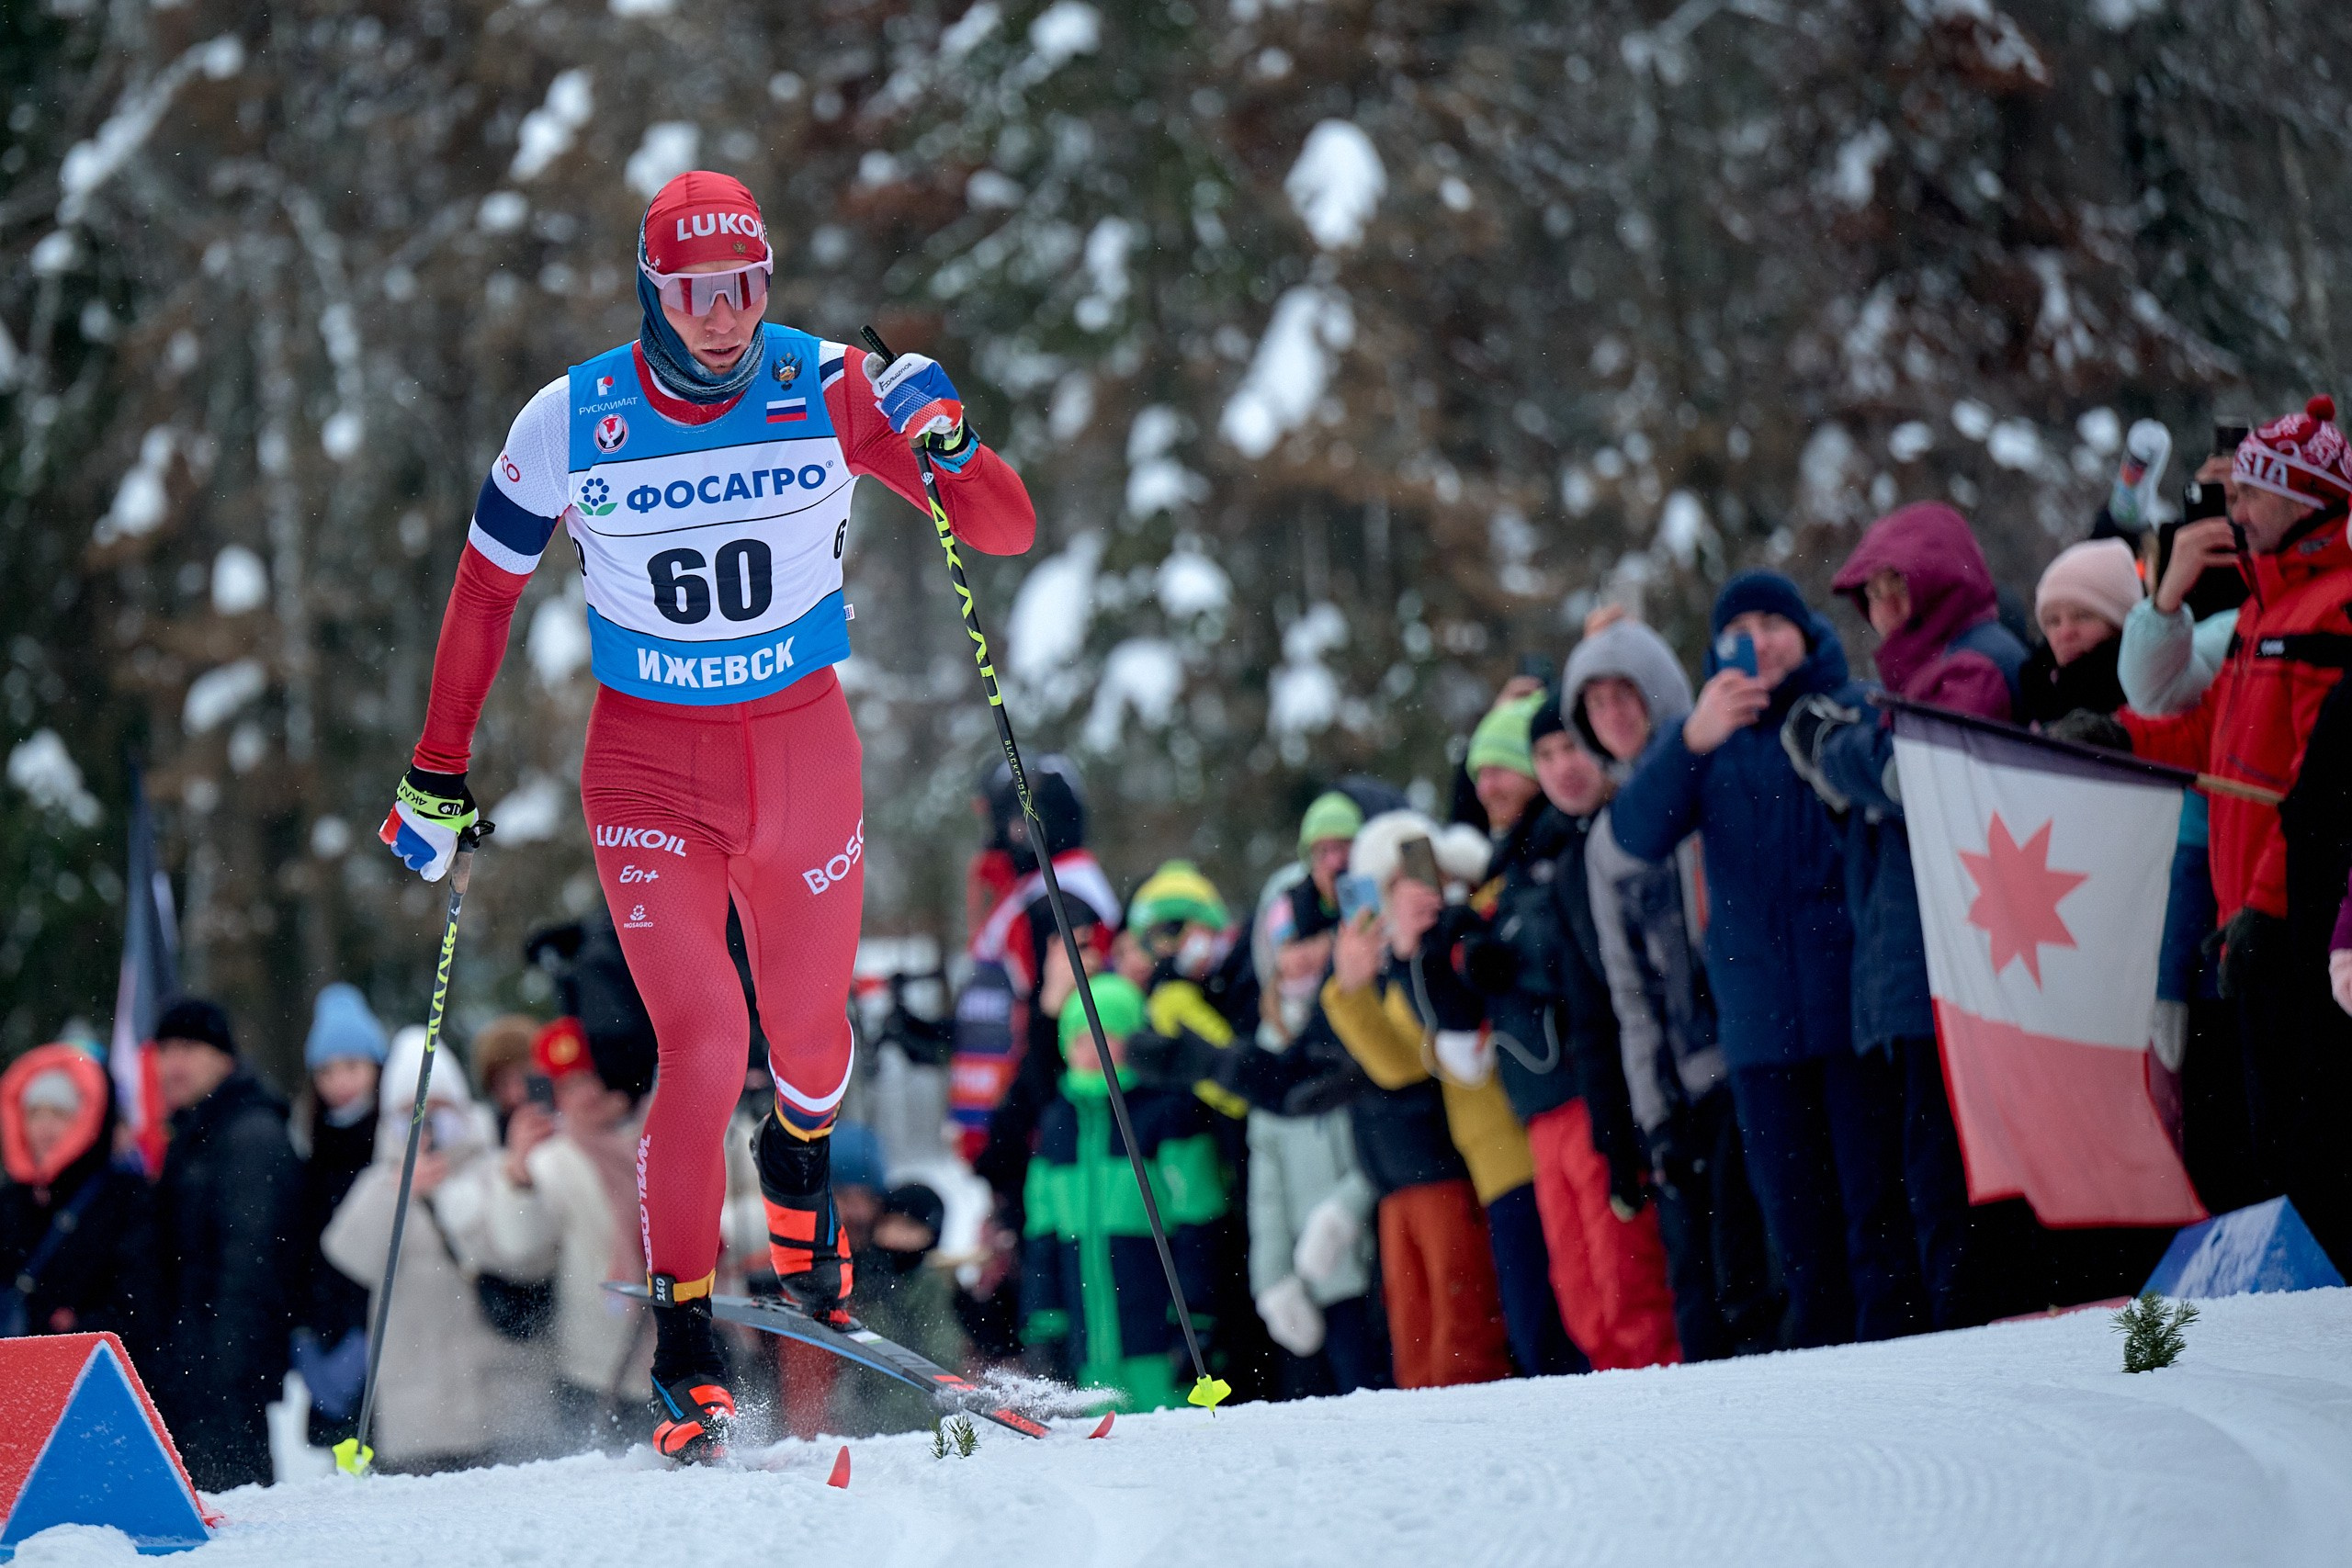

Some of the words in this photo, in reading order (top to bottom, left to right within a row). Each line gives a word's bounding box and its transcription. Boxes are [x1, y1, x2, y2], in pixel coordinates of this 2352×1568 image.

[579, 396, 639, 416] РУСКЛИМАТ
[647, 538, 773, 625] 60
[637, 635, 796, 689] ИЖЕВСК
[595, 824, 687, 858] LUKOIL
[801, 810, 865, 896] BOSC
[655, 1276, 667, 1303] 260
